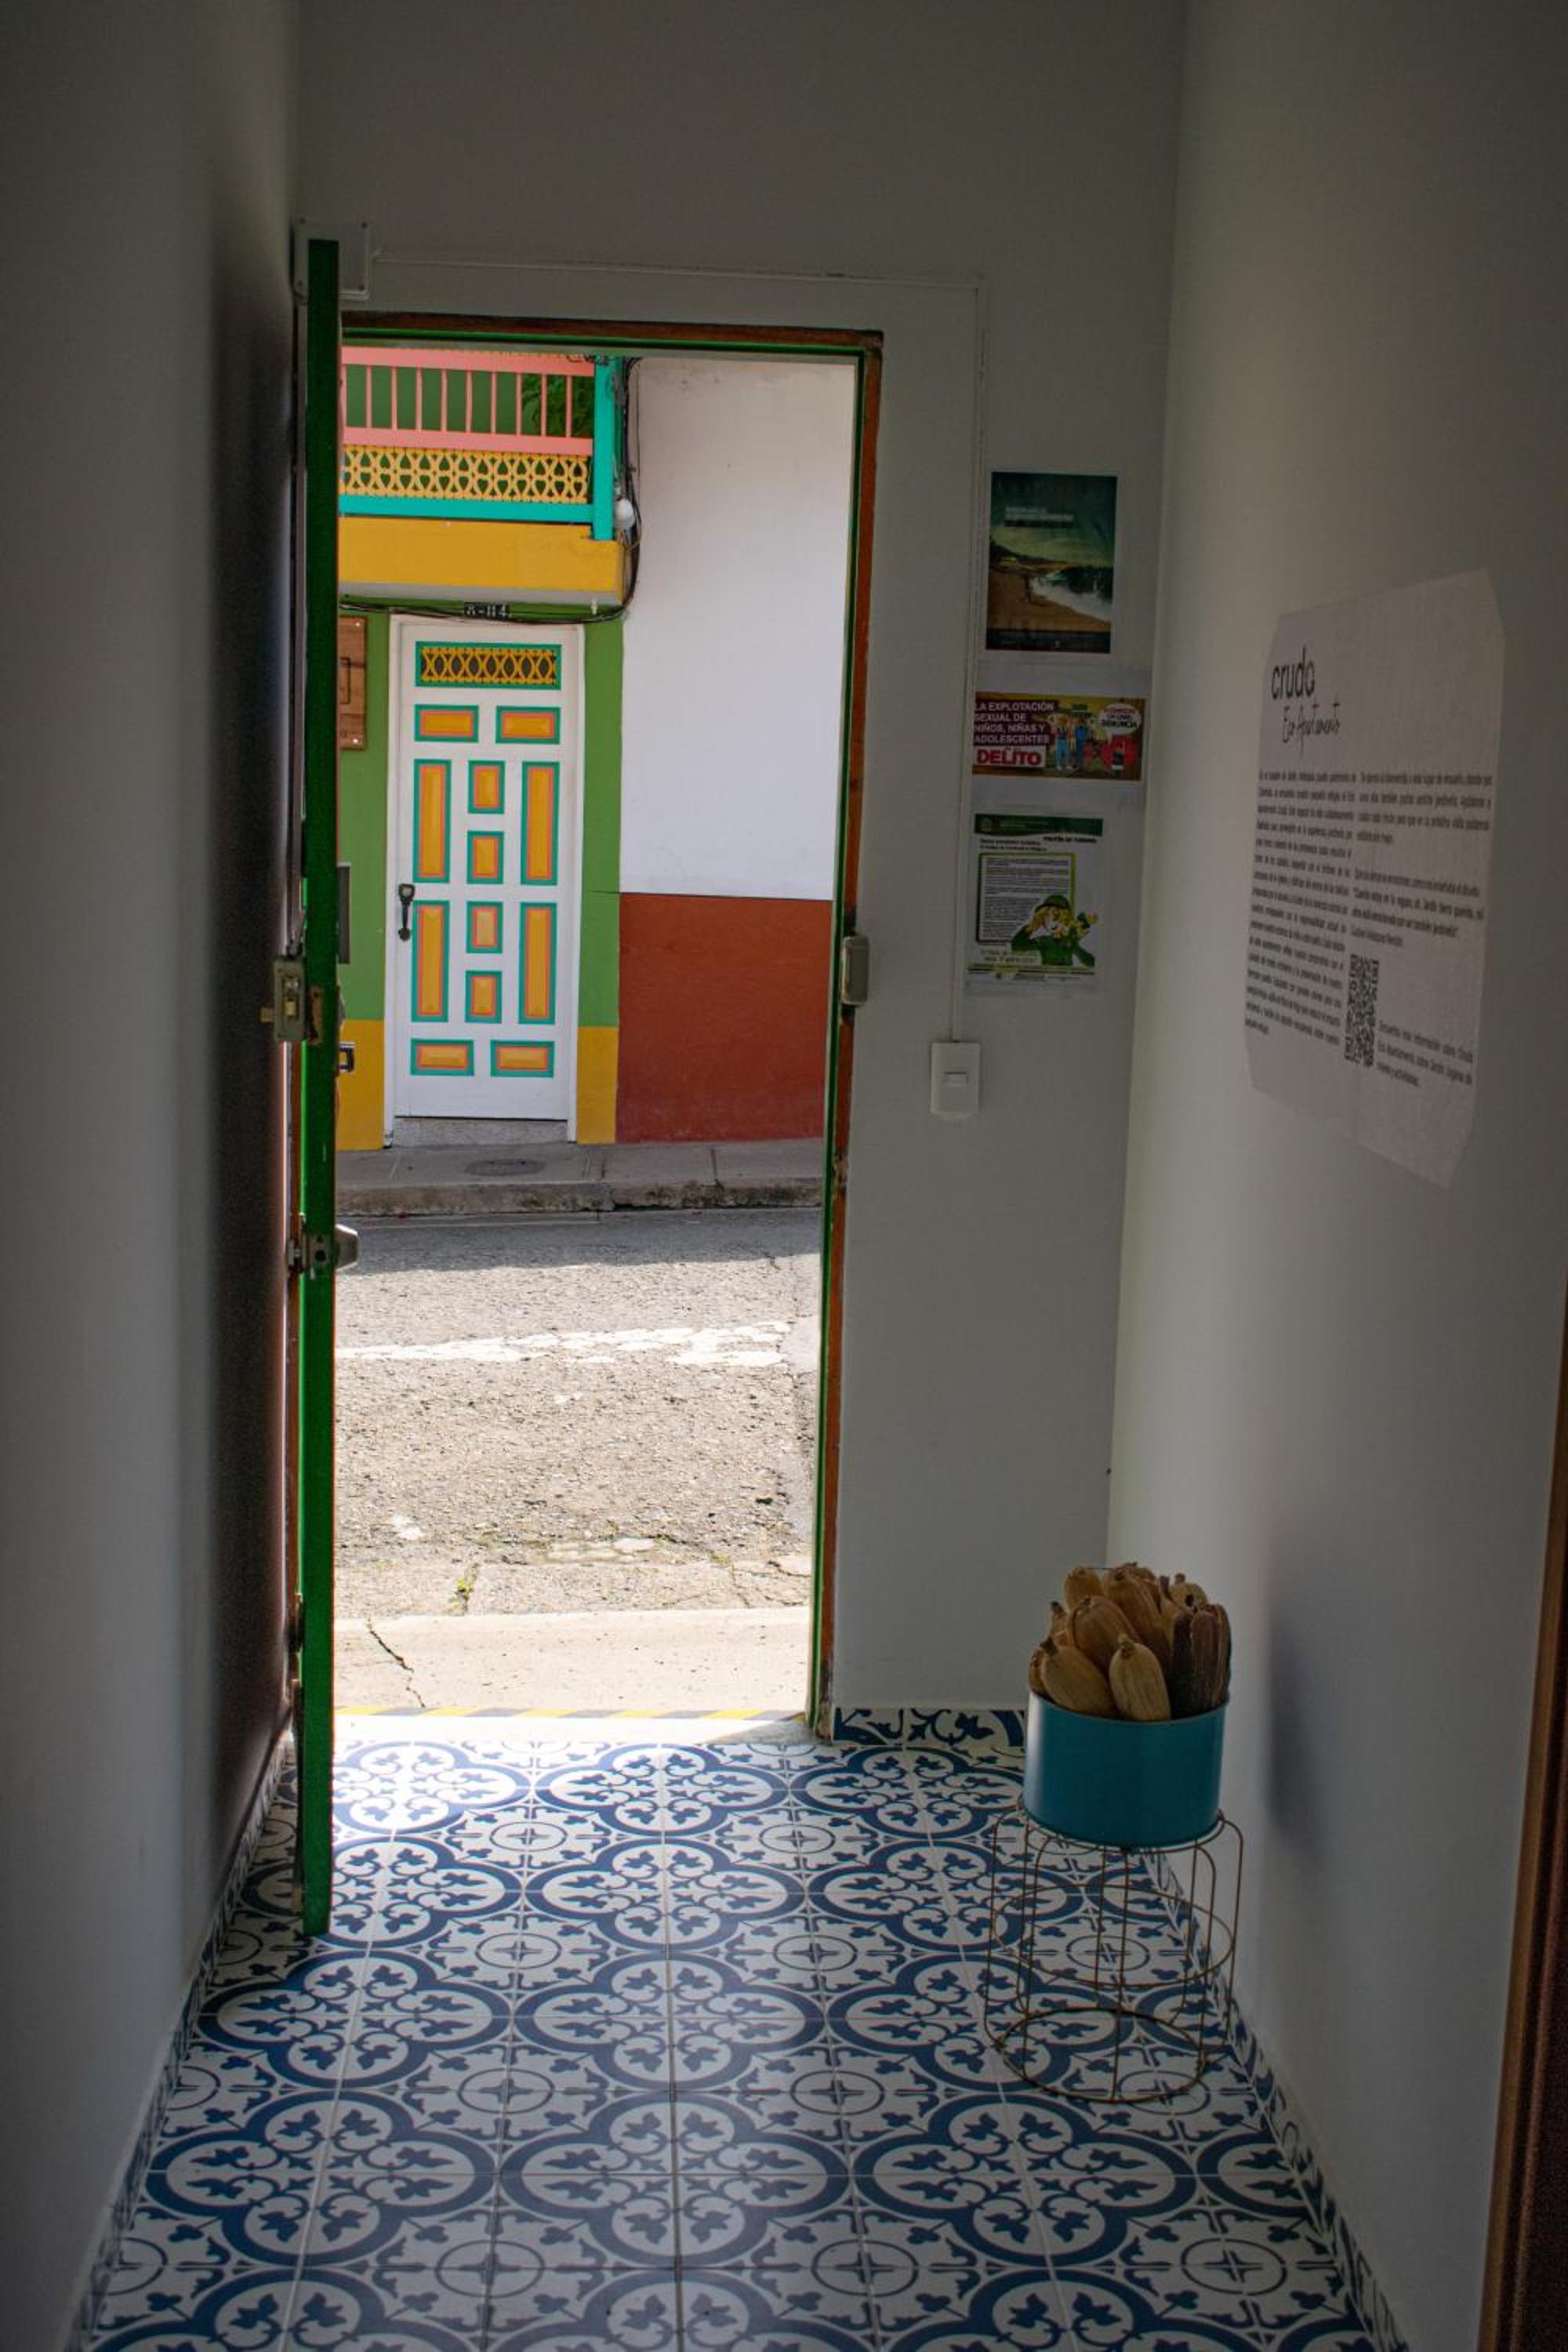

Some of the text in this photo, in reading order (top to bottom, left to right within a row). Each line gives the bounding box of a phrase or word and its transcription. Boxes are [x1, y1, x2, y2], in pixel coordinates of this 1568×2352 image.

[1272, 644, 1316, 700] crudo
[975, 701, 1054, 713] LA EXPLOTACIÓN
[975, 713, 1026, 722] SEXUAL DE
[1007, 723, 1036, 733] NIÑAS
[977, 749, 1042, 766] DELITO
